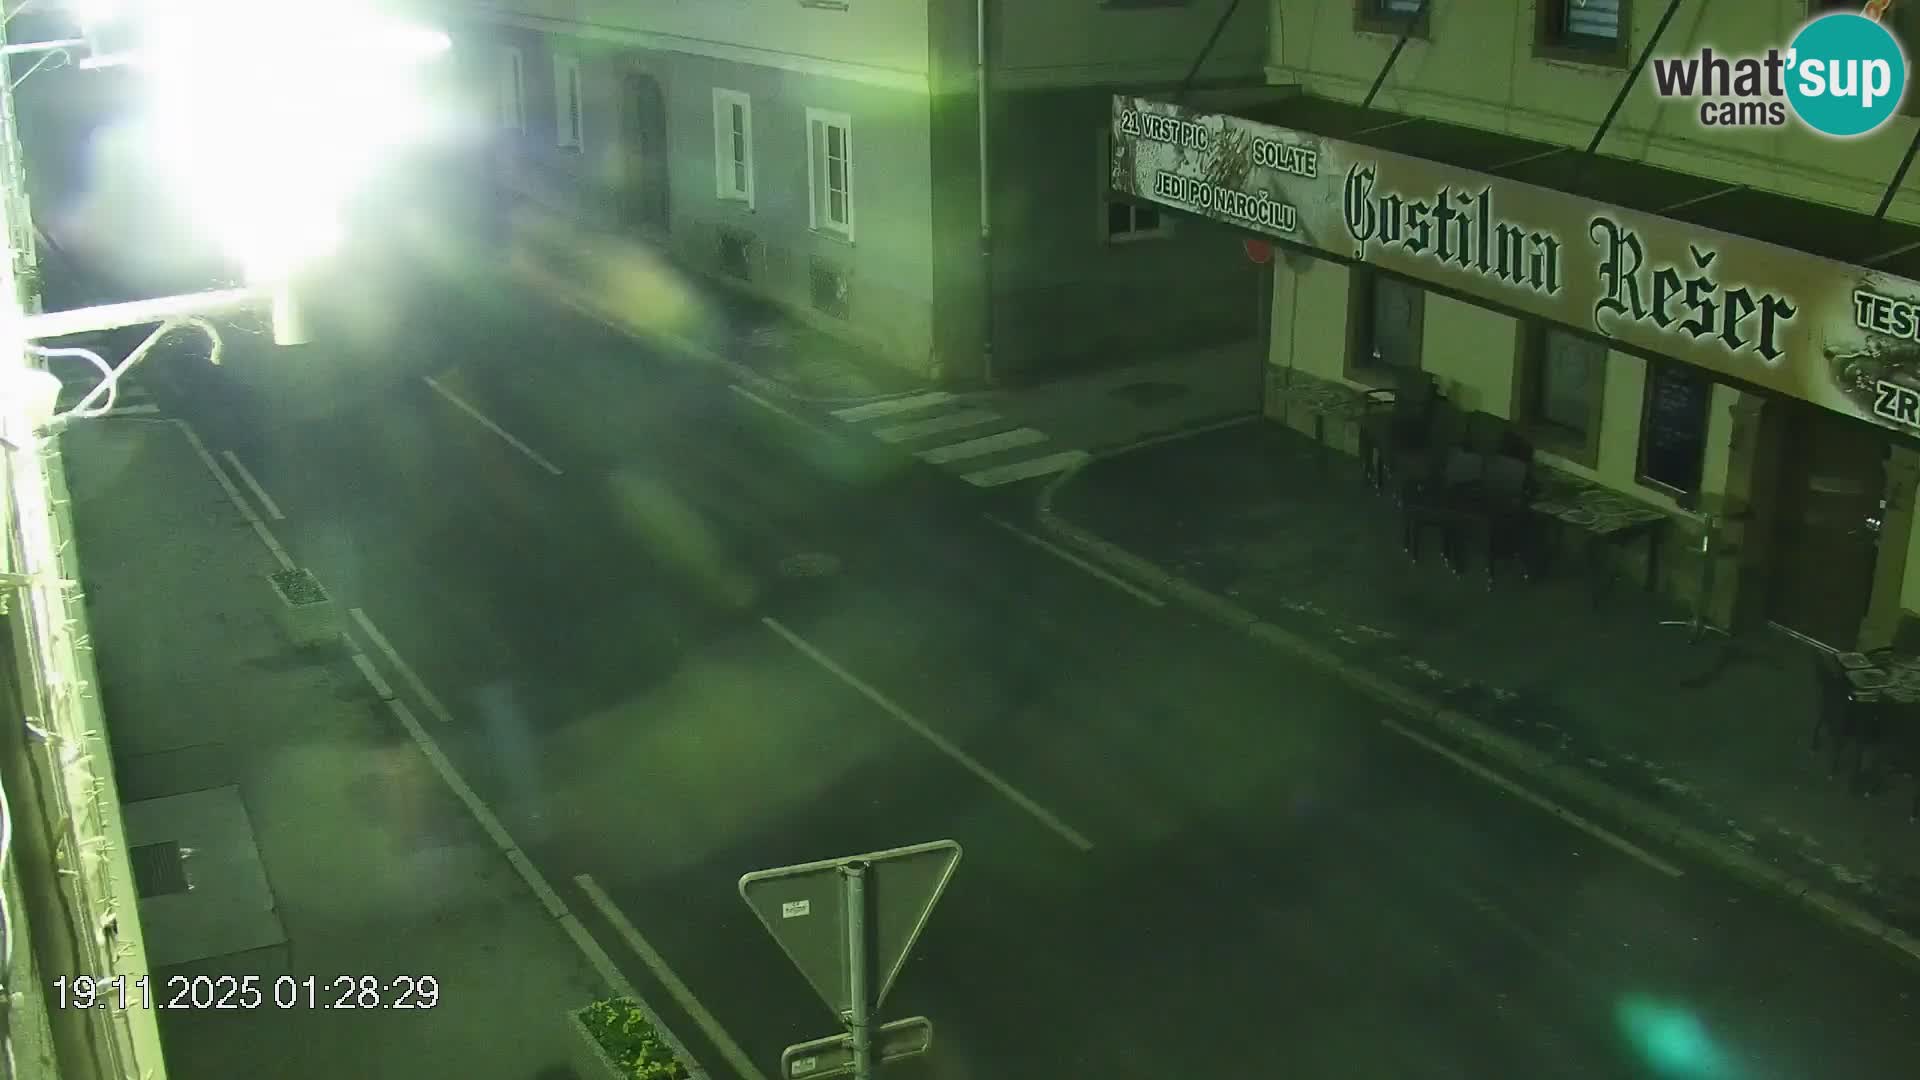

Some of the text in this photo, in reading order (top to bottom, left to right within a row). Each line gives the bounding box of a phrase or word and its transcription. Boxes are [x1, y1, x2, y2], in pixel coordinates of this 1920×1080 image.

[1121, 109, 1208, 150] 21 VRST PIC
[1253, 138, 1317, 178] SOLATE
[1155, 172, 1296, 232] JEDI PO NAROČILU
[1343, 160, 1798, 361] Gostilna Rešer
